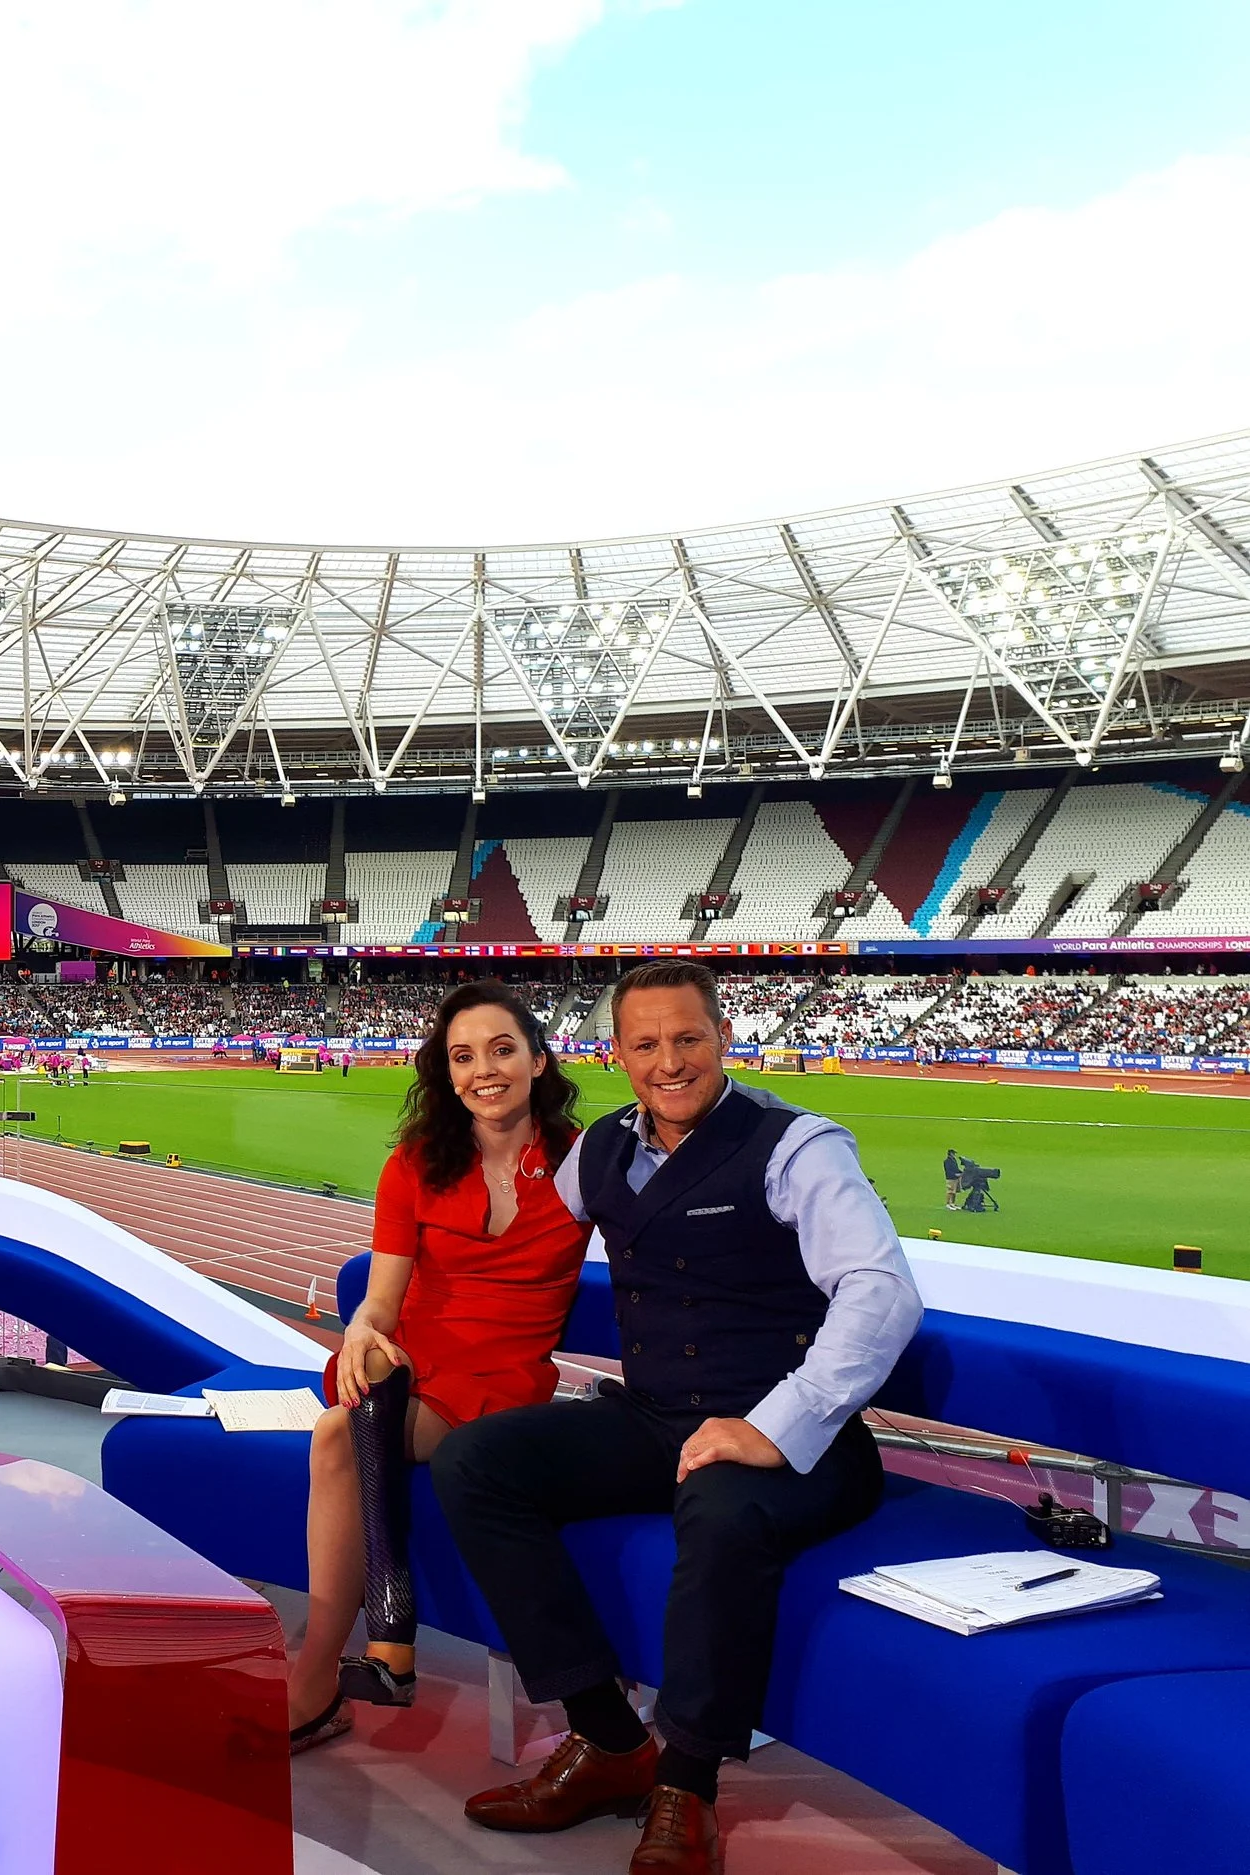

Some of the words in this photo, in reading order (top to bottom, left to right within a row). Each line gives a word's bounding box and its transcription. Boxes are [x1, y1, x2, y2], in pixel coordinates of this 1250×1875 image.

[1082, 942, 1107, 950] Para
[1110, 940, 1154, 950] Athletics
[1156, 941, 1223, 950] CHAMPIONSHIPS
[1079, 1052, 1111, 1060] LOTTERY
[1079, 1058, 1109, 1066] FUNDED
[1161, 1062, 1191, 1070] FUNDED
